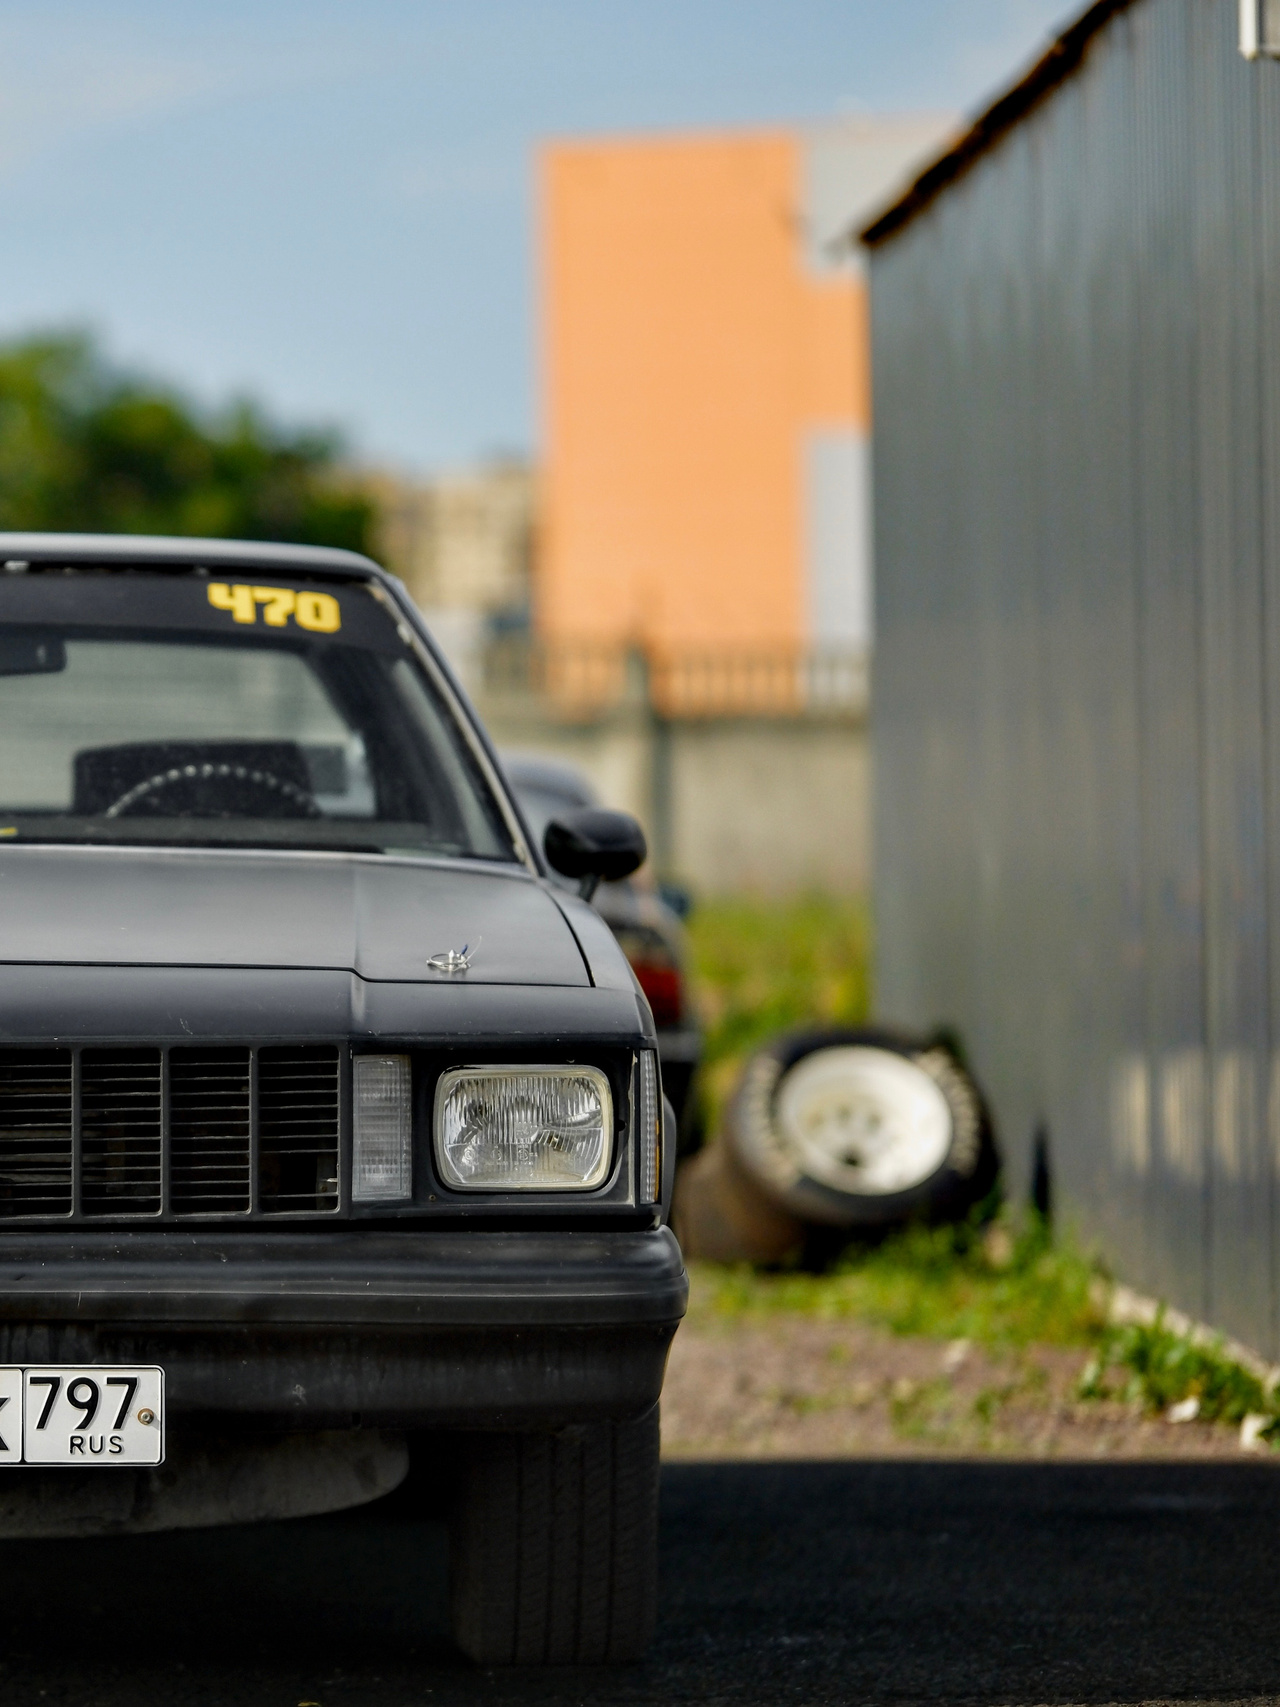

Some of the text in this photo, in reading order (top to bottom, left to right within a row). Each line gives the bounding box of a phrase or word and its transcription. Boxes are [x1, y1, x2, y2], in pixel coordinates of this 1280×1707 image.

[207, 582, 342, 634] 470
[29, 1376, 138, 1430] 797
[69, 1434, 124, 1454] RUS
